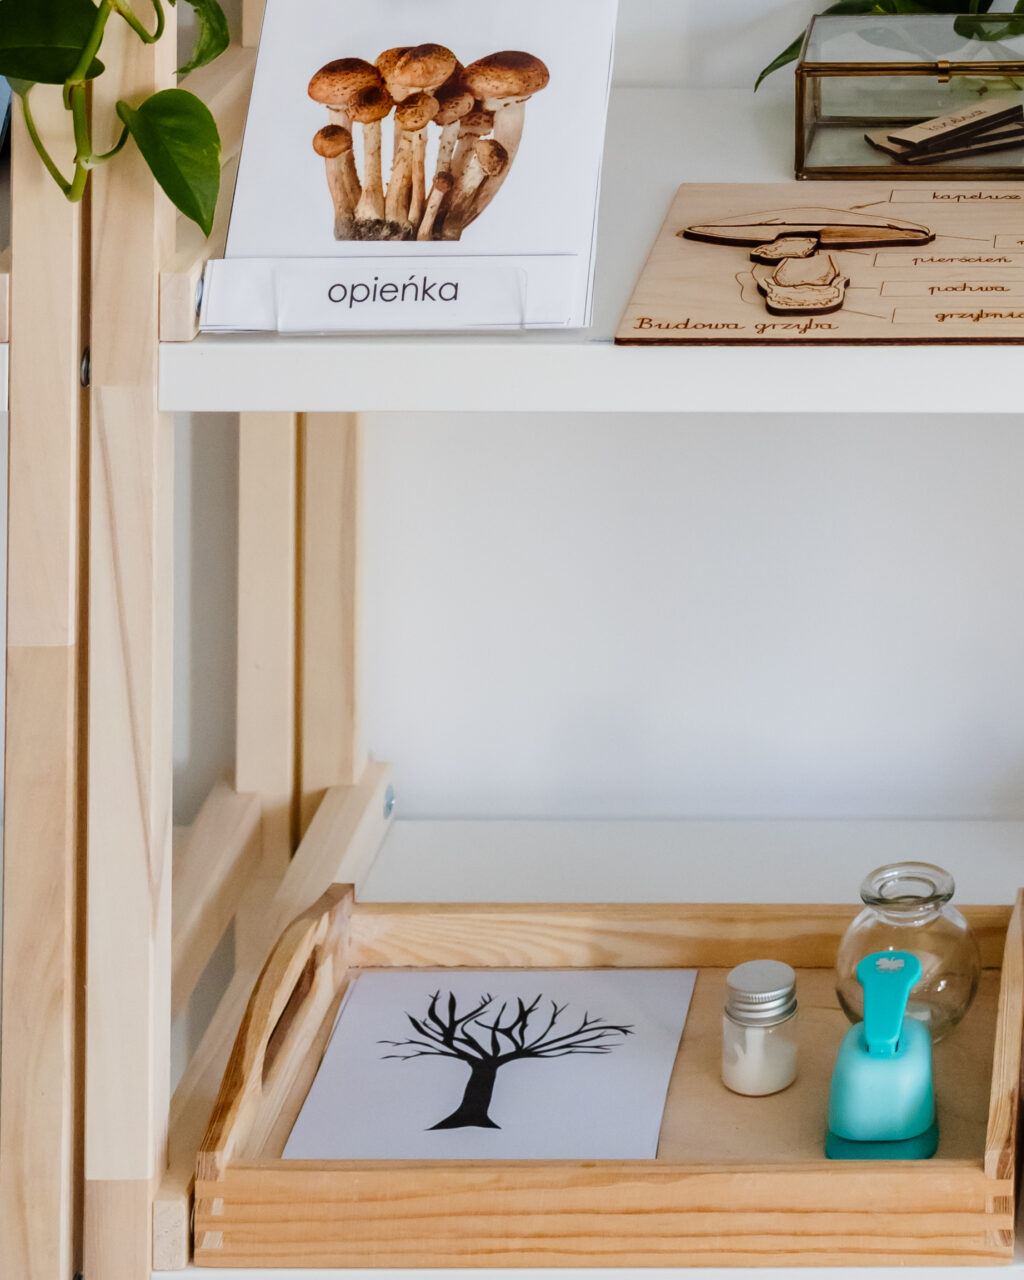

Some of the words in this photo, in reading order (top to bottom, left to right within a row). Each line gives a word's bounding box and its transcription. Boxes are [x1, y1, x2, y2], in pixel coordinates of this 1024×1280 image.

[931, 191, 1022, 203] kapelusz
[911, 255, 1013, 266] pierścień
[327, 274, 459, 309] opieńka
[928, 282, 1011, 296] pochwa
[632, 316, 746, 331] Budowa
[754, 317, 840, 335] grzyba
